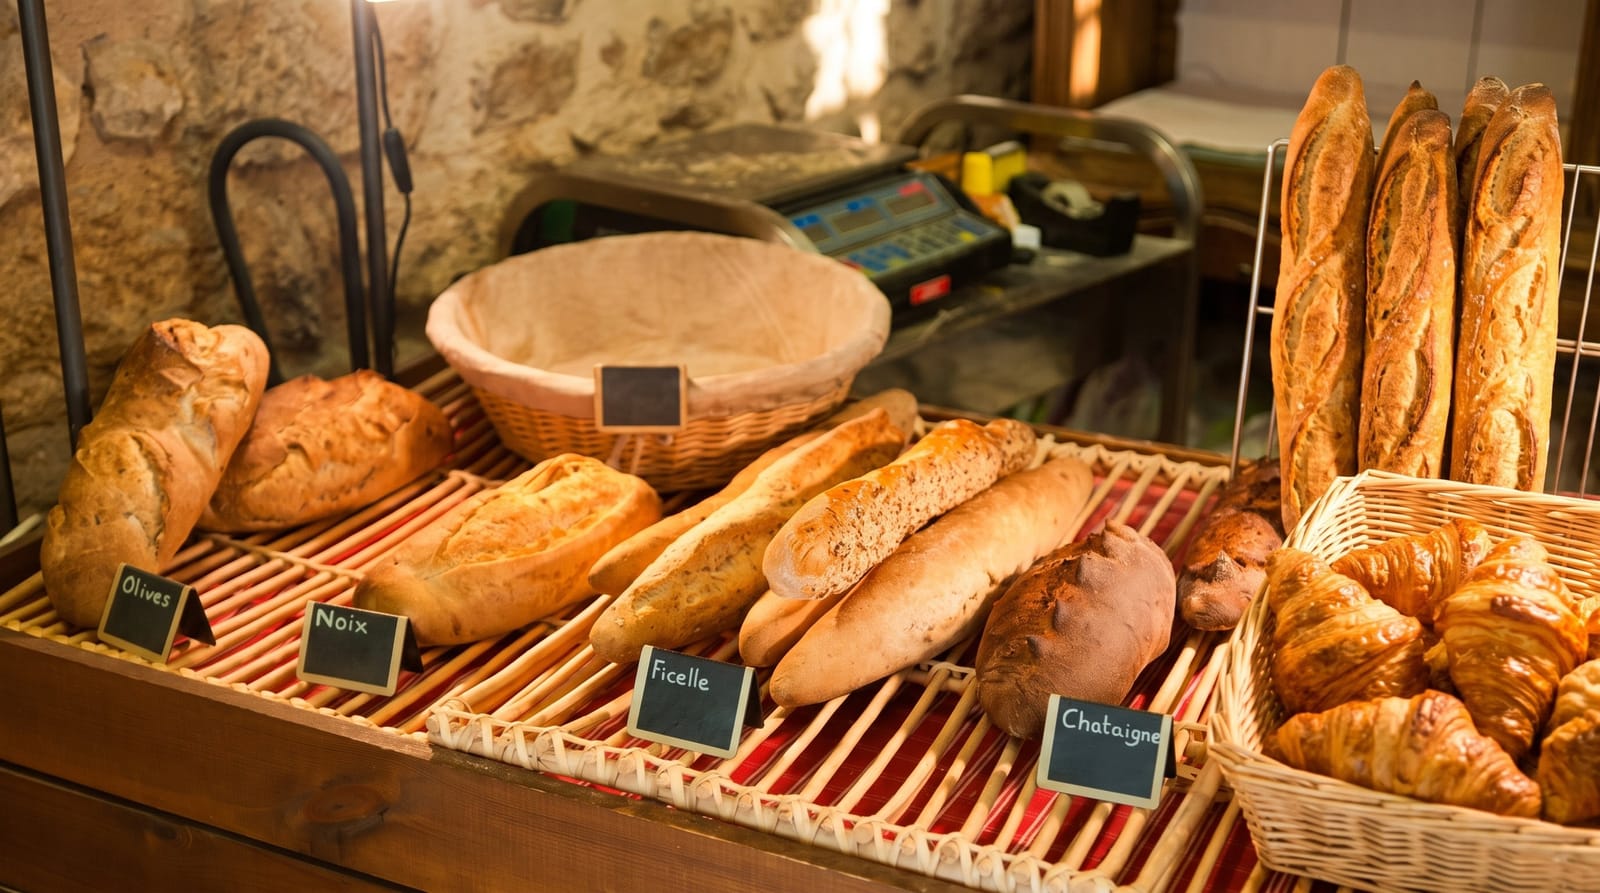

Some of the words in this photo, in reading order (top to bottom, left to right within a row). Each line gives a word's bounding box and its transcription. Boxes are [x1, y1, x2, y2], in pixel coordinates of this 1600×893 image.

[122, 575, 171, 608] Olives
[315, 608, 368, 634] Noix
[651, 658, 710, 691] Ficelle
[1062, 708, 1161, 746] Chataigne
